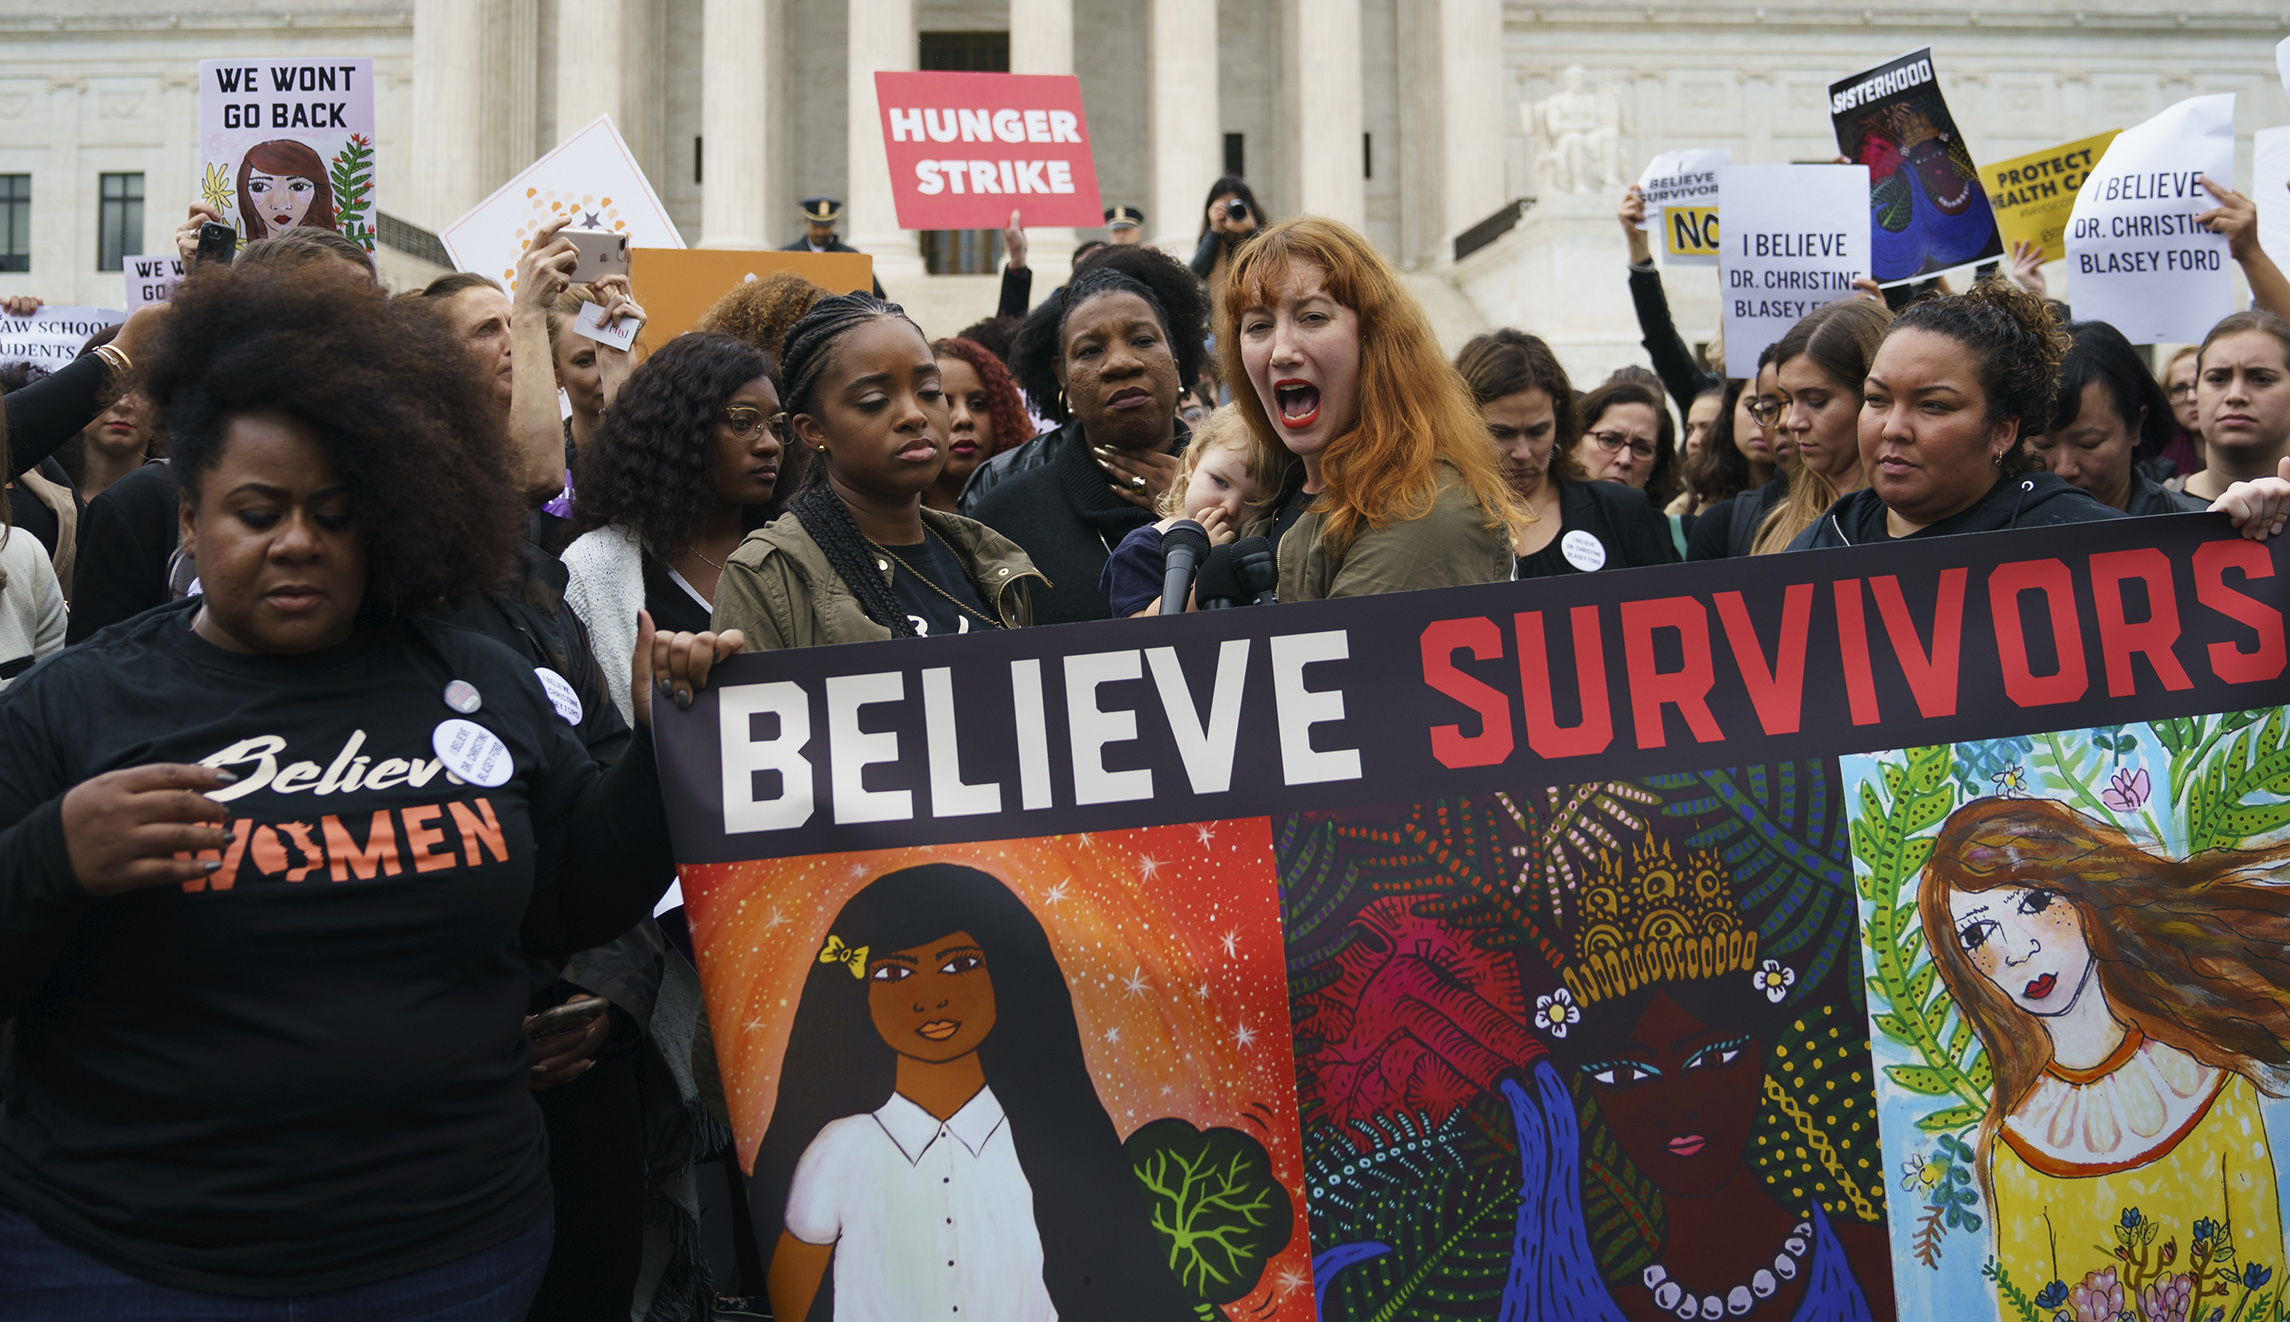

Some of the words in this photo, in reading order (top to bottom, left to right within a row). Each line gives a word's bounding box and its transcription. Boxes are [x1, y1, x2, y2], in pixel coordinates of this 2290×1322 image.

[215, 68, 258, 93] WE
[270, 66, 356, 92] WONT
[1832, 58, 1932, 115] SISTERHOOD
[224, 104, 260, 129] GO
[272, 103, 347, 128] BACK
[889, 108, 1082, 143] HUNGER
[915, 159, 1075, 195] STRIKE
[1650, 172, 1715, 190] BELIEVE
[1997, 149, 2092, 188] PROTECT
[1640, 184, 1719, 203] SURVIVOR
[2093, 180, 2103, 202] I
[2106, 171, 2204, 201] BELIEVE
[2075, 217, 2106, 239] DR.
[2112, 213, 2223, 238] CHRISTIN
[1743, 234, 1748, 257] I
[1756, 234, 1847, 257] BELIEVE
[135, 261, 163, 278] WE
[2080, 251, 2160, 274] BLASEY
[2167, 250, 2220, 271] FORD
[1730, 270, 1759, 288] DR.
[143, 285, 165, 301] GO
[1735, 300, 1805, 318] BLASEY
[0, 320, 32, 333] AW
[0, 343, 75, 359] UDENTS
[719, 630, 1362, 835] BELIEVE
[1419, 538, 2287, 769] SURVIVORS
[187, 729, 466, 802] Believ
